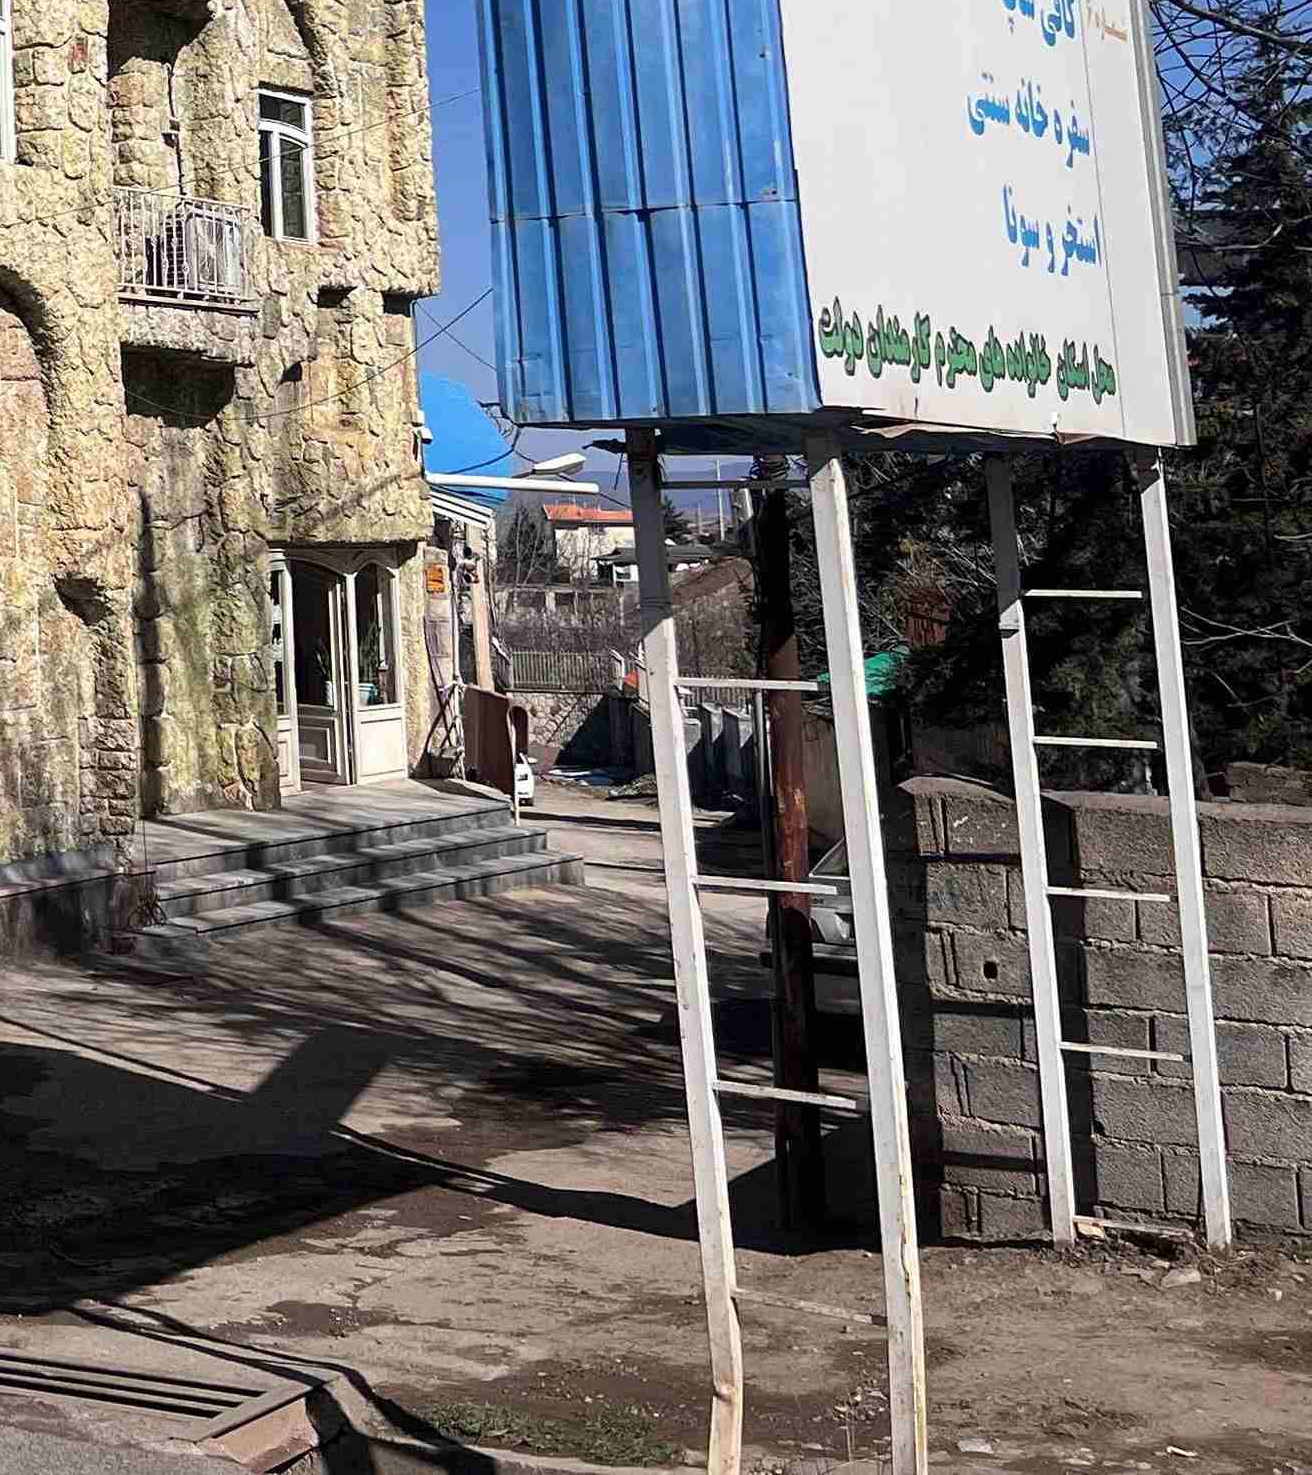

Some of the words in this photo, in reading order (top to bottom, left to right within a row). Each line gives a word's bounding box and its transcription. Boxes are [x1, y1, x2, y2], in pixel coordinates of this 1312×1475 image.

[967, 71, 1010, 137] سنتی
[1015, 77, 1049, 139] خانه
[1002, 182, 1041, 268] سونا
[1045, 220, 1056, 275] و
[1061, 203, 1103, 278] استخر
[818, 295, 864, 377] دولت
[934, 325, 978, 389] محترم
[1056, 336, 1091, 402] اسکان
[1092, 343, 1117, 406] محل
